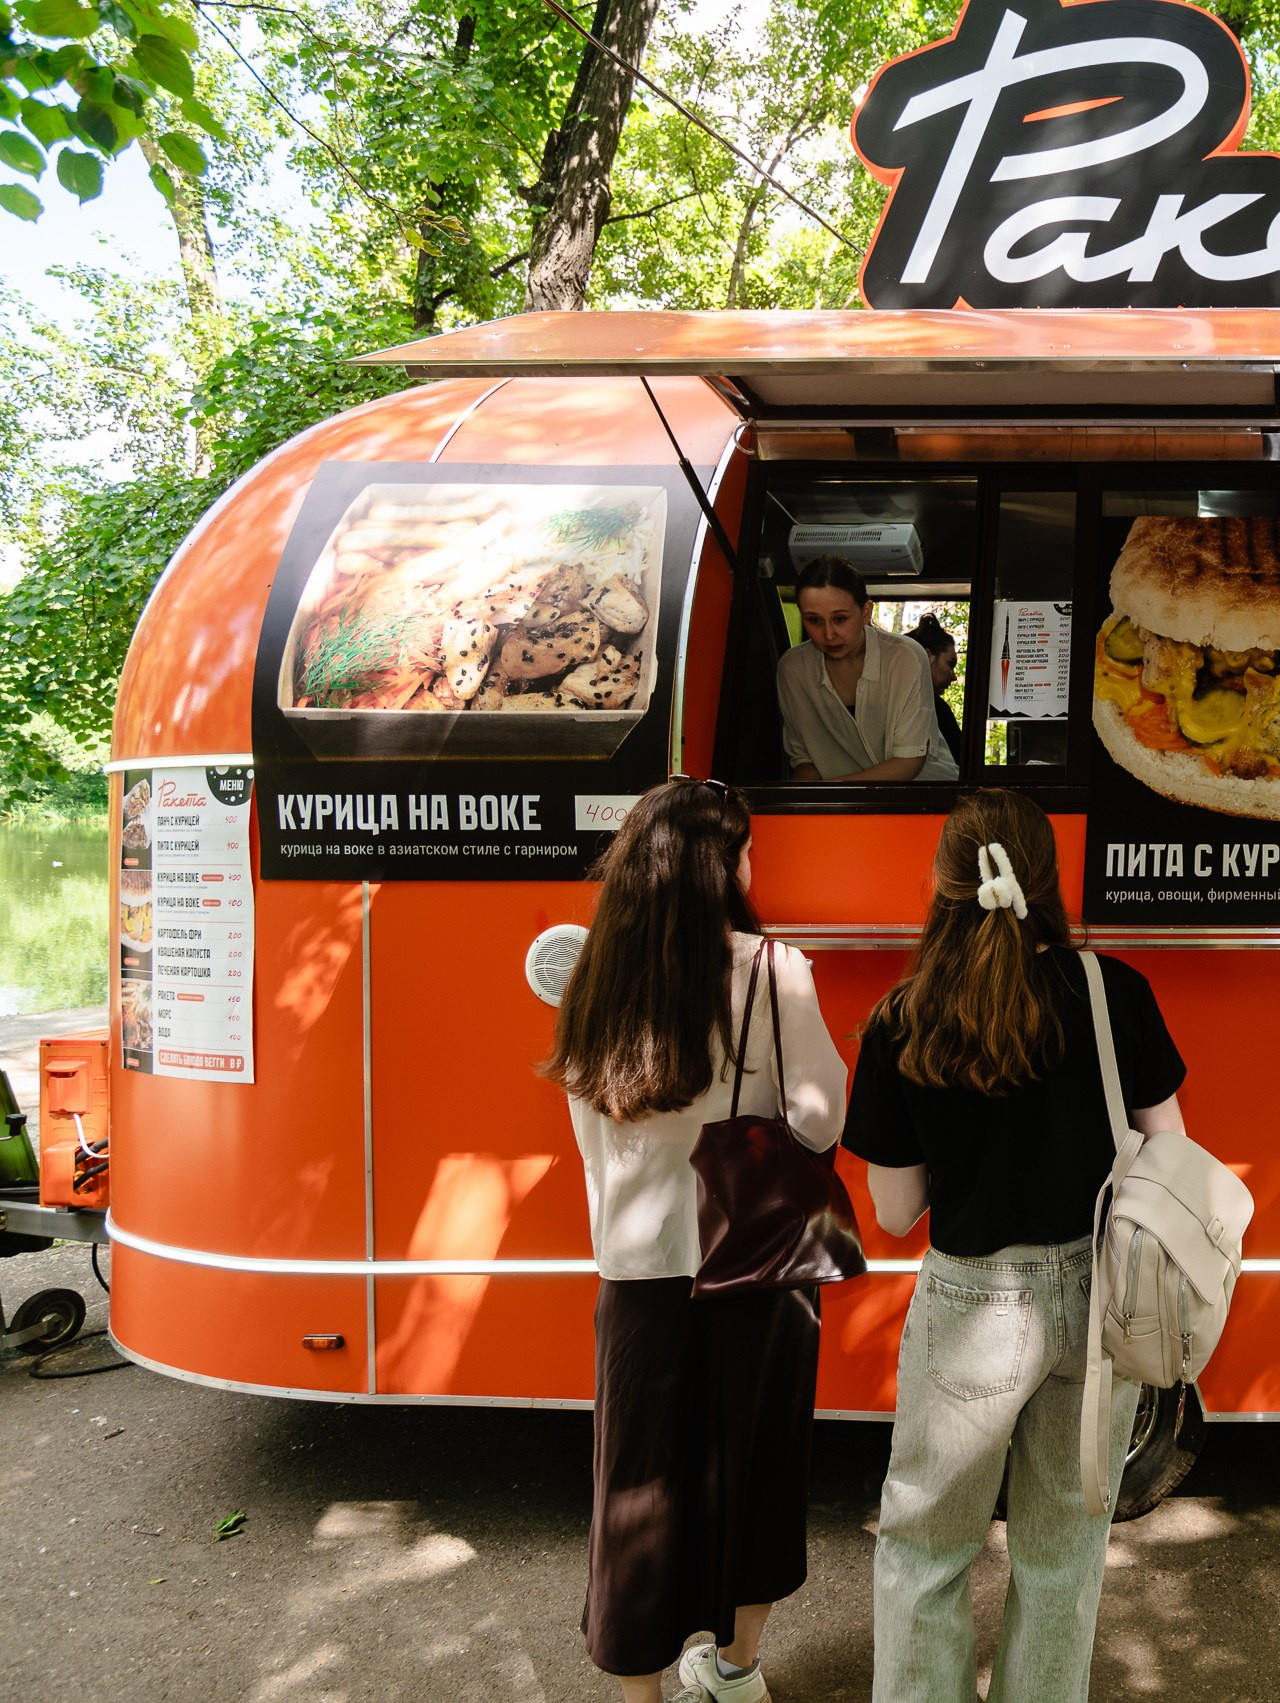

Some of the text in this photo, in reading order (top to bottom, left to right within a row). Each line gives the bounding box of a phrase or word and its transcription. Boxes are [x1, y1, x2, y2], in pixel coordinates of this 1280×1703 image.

[220, 780, 243, 791] МЕНЮ
[158, 779, 207, 808] Ракета
[277, 794, 542, 836] КУРИЦА НА ВОКЕ
[586, 803, 627, 823] 400
[175, 814, 199, 827] КУРИЦЕЙ
[174, 839, 199, 851] КУРИЦЕЙ
[280, 844, 578, 858] курица на воке в азиатском стиле с гарниром
[1105, 843, 1184, 877] ПИТА
[1194, 843, 1213, 877] С
[185, 872, 199, 882] ВОКЕ
[1105, 889, 1154, 903] курица,
[1158, 889, 1203, 903] овощи,
[185, 898, 200, 907] ВОКЕ
[189, 930, 201, 939] ФРИ
[186, 948, 211, 959] КАПУСТА
[158, 1010, 171, 1019] МОРС
